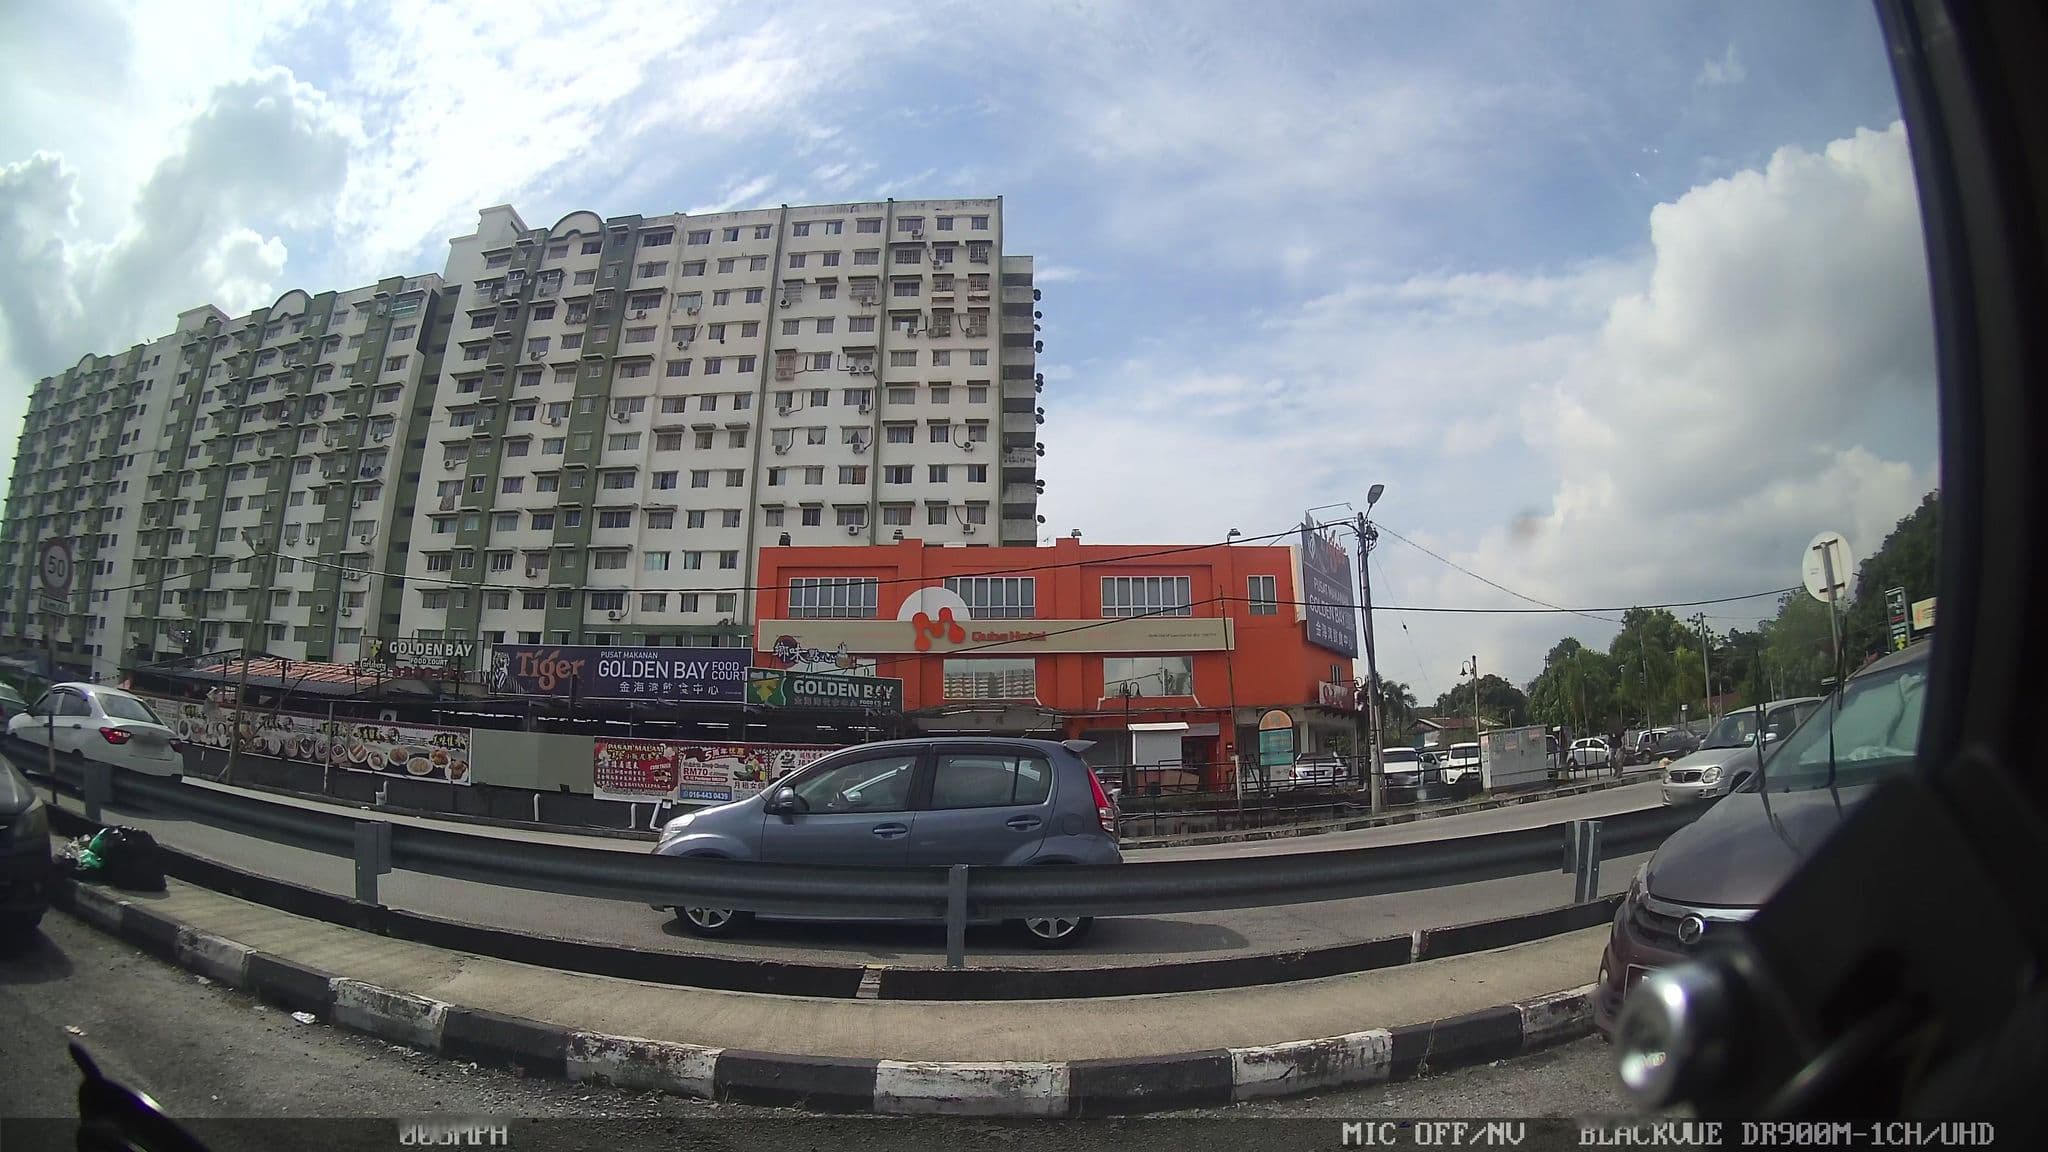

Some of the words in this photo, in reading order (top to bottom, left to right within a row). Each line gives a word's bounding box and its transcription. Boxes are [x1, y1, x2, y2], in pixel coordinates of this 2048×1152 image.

[47, 554, 66, 578] 50
[1309, 594, 1335, 621] GOLDEN
[389, 641, 443, 656] GOLDEN
[446, 643, 473, 657] BAY
[600, 650, 623, 659] PUSAT
[623, 651, 659, 660] MAKANAN
[410, 657, 426, 665] FOOD
[428, 658, 448, 667] COURT
[516, 648, 585, 691] Tiger
[598, 660, 669, 679] GOLDEN
[673, 661, 709, 680] BAY
[711, 661, 740, 671] FOOD
[711, 670, 746, 681] COURT
[793, 679, 860, 698] GOLDEN
[683, 767, 708, 776] RM70
